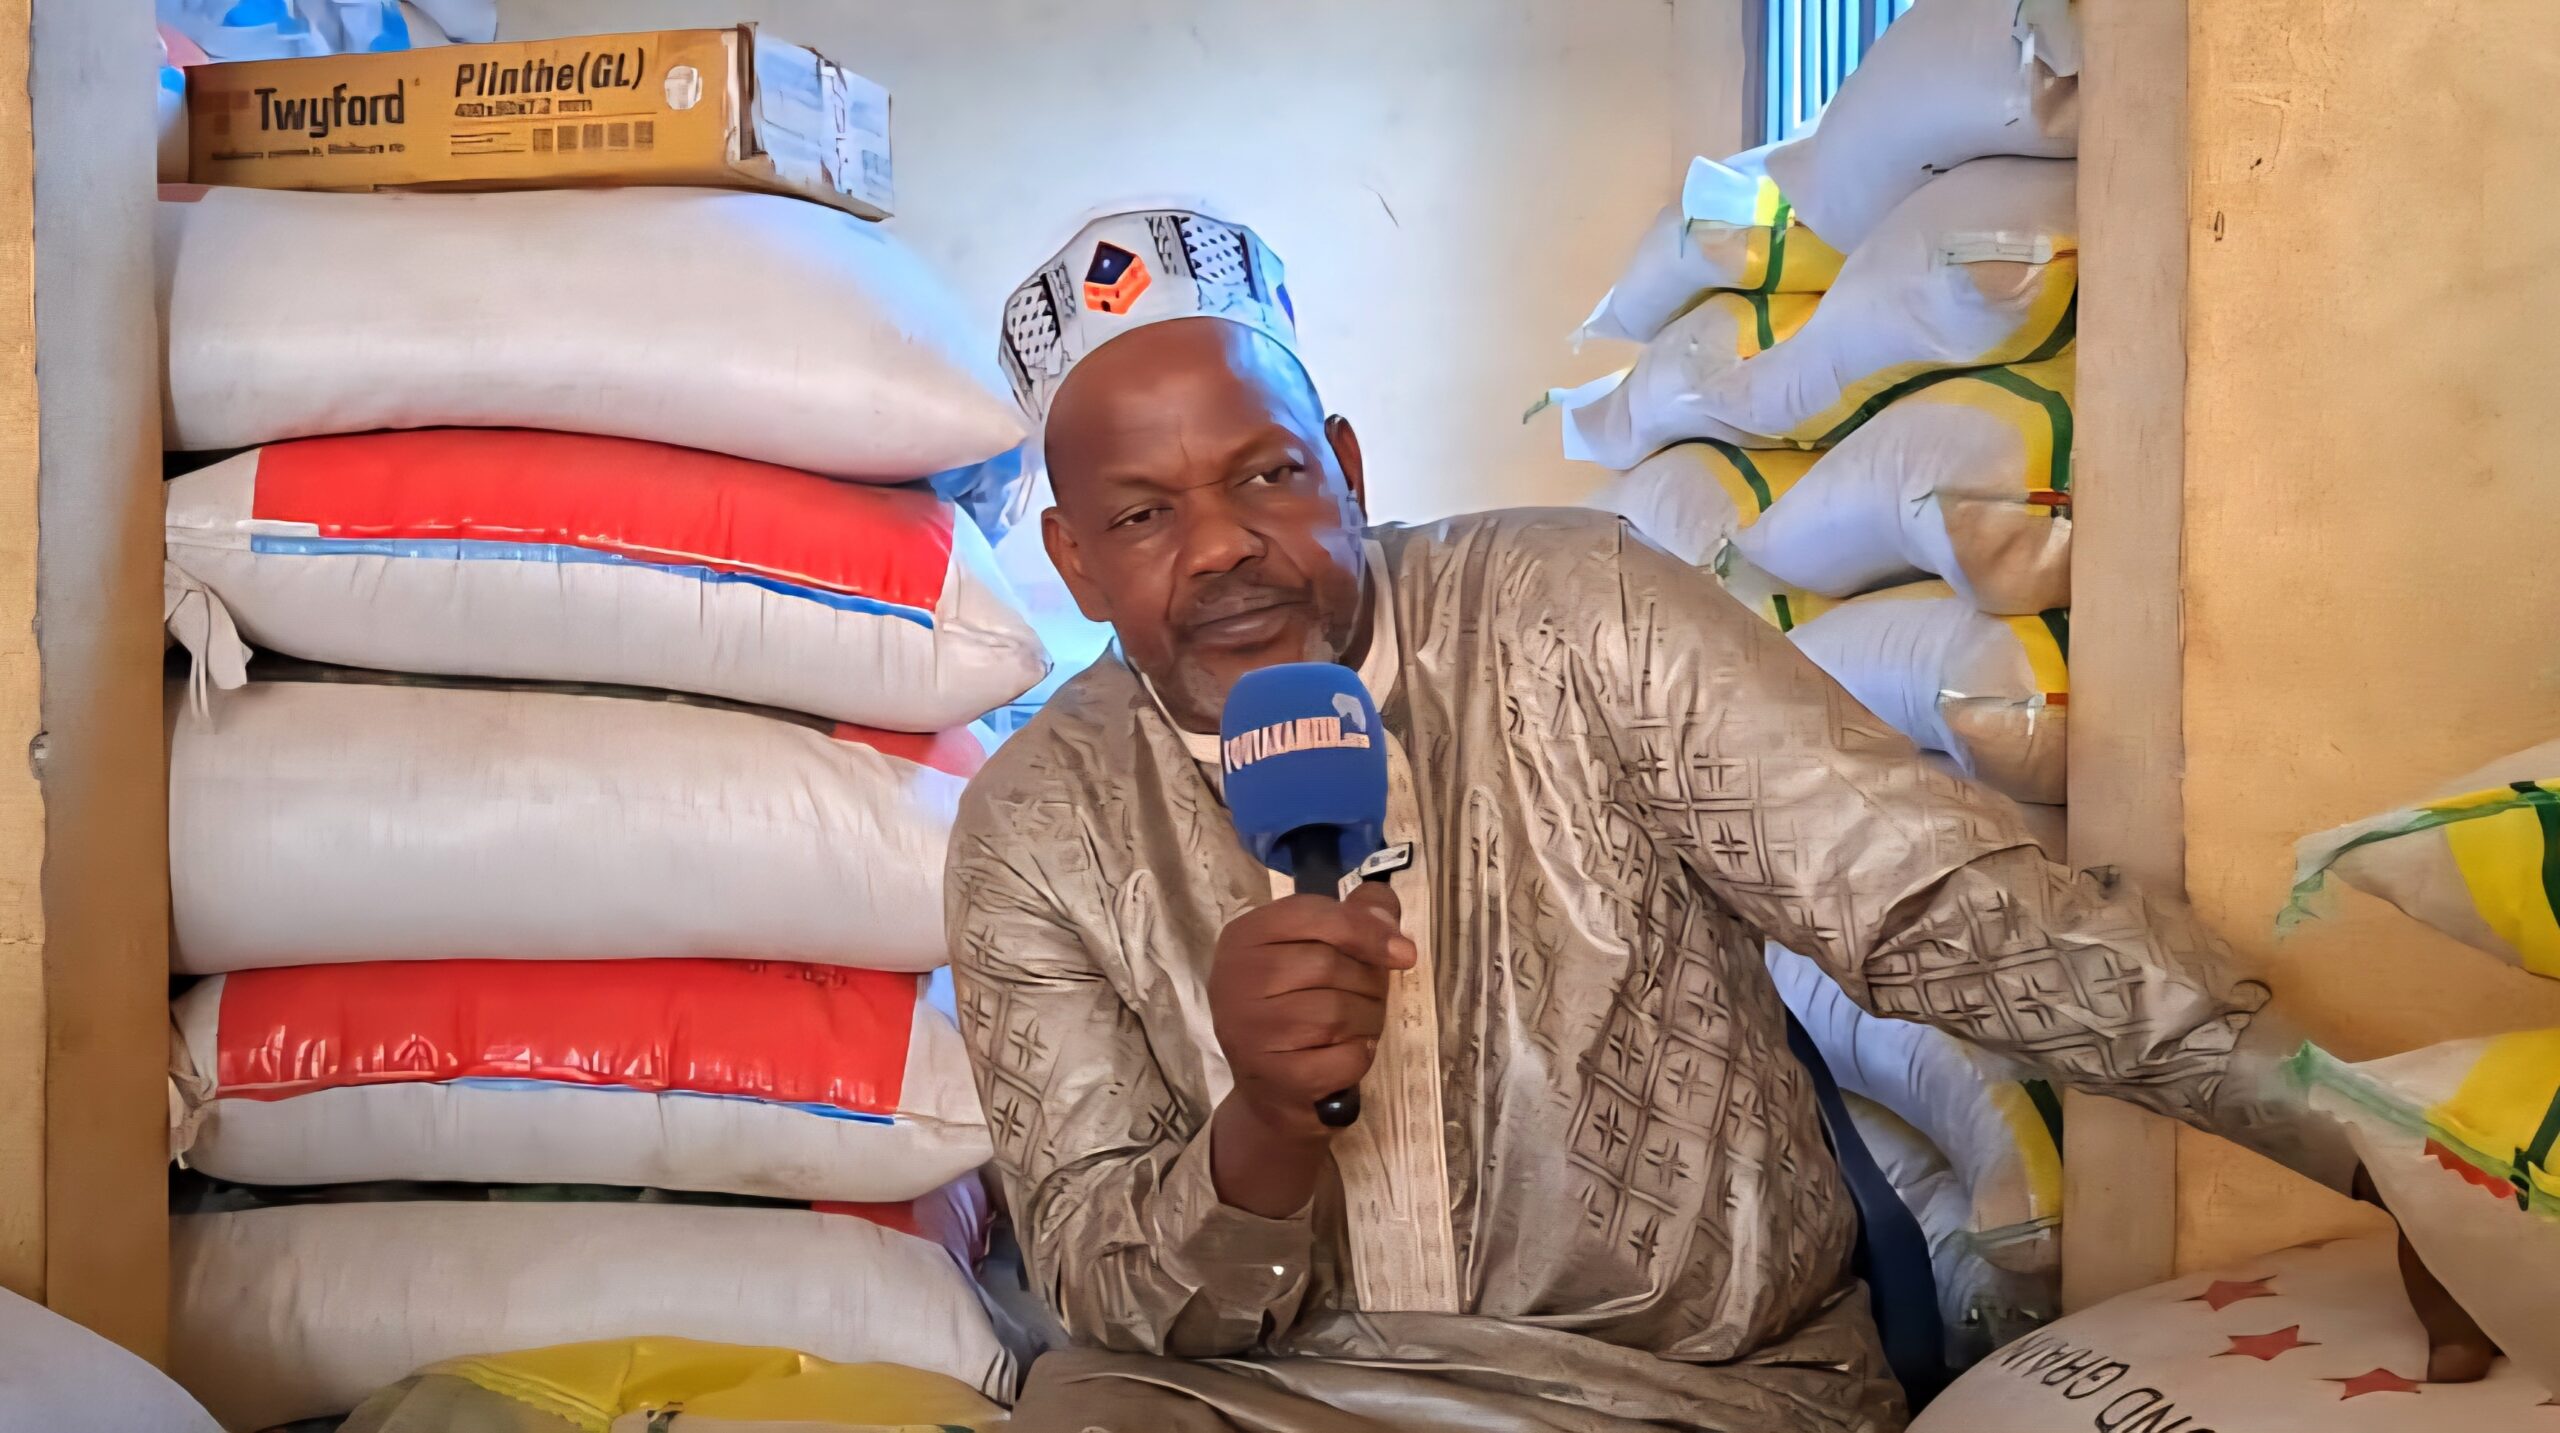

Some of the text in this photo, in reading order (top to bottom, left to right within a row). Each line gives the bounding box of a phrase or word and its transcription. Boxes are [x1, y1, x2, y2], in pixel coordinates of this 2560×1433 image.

[454, 47, 645, 98] Plinthe(GL)
[254, 78, 405, 138] Twyford
[2094, 1387, 2216, 1433] ND
